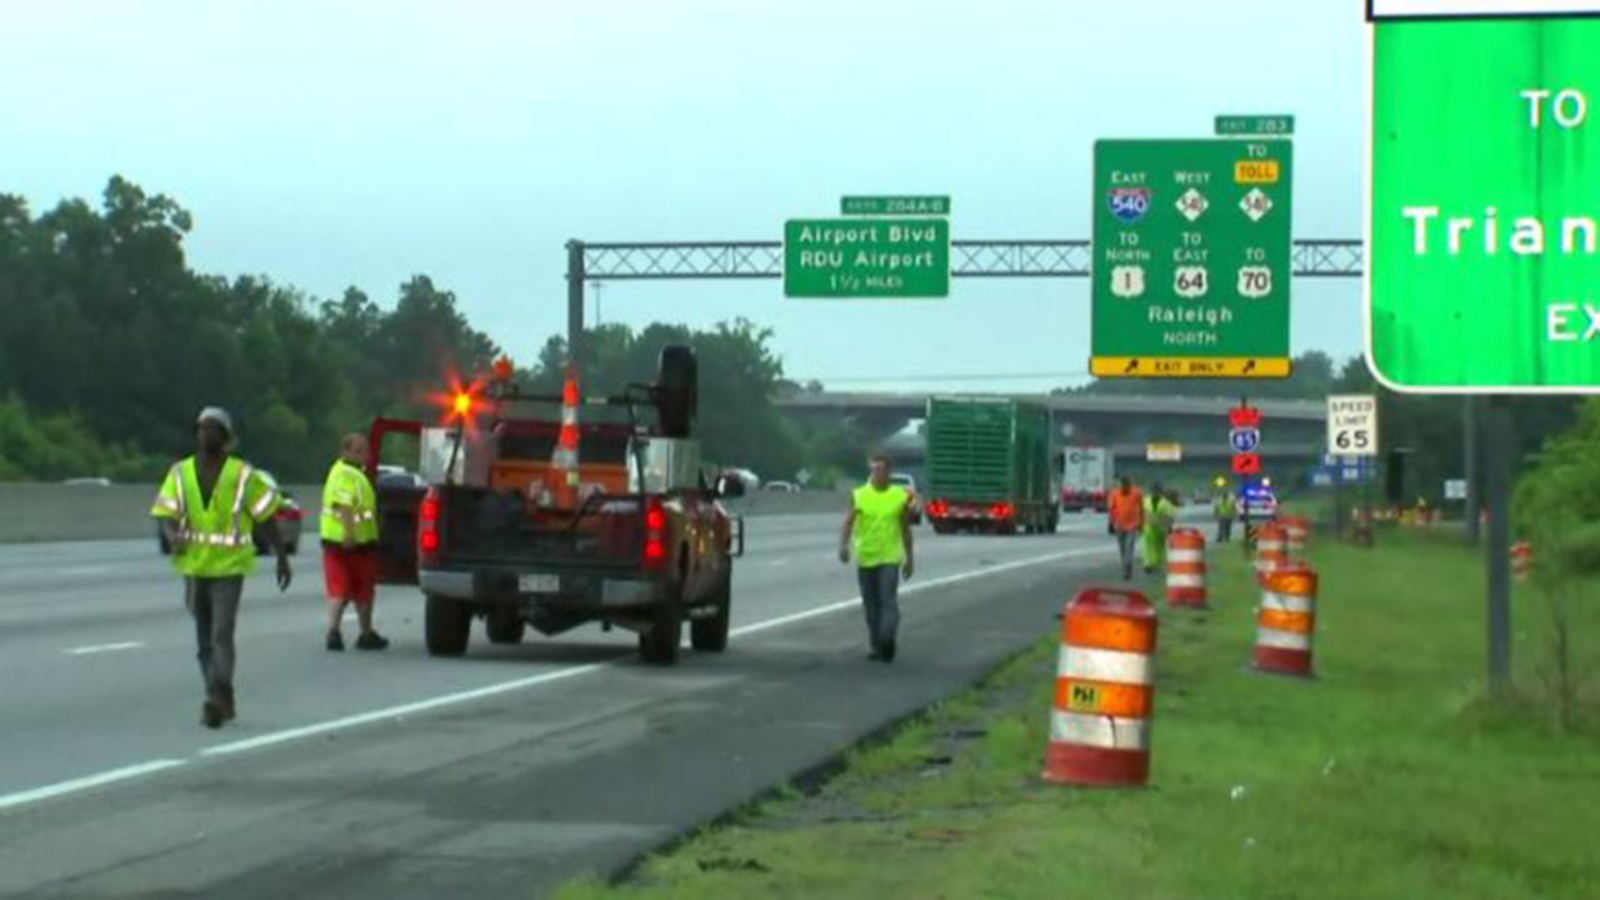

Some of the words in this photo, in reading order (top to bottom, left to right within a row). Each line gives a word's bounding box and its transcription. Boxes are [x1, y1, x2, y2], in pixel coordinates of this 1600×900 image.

[1520, 89, 1587, 128] TO
[1246, 144, 1267, 157] TO
[1239, 164, 1276, 178] TOLL
[1112, 197, 1147, 211] 540
[800, 226, 878, 245] Airport
[889, 225, 937, 242] Blvd
[1401, 206, 1599, 255] Trian
[1118, 232, 1139, 245] TO
[1182, 232, 1202, 245] TO
[800, 251, 843, 267] RDU
[854, 251, 934, 270] Airport
[1245, 248, 1266, 261] TO
[1124, 272, 1132, 291] 1
[1177, 272, 1204, 291] 64
[1242, 272, 1268, 291] 70
[1148, 306, 1233, 325] Raleigh
[1163, 332, 1217, 345] NORTH
[1155, 362, 1181, 372] EXIT
[1189, 362, 1224, 372] ONLY
[1331, 401, 1373, 412] SPEED
[1335, 415, 1367, 426] LIMIT
[1336, 430, 1369, 449] 65
